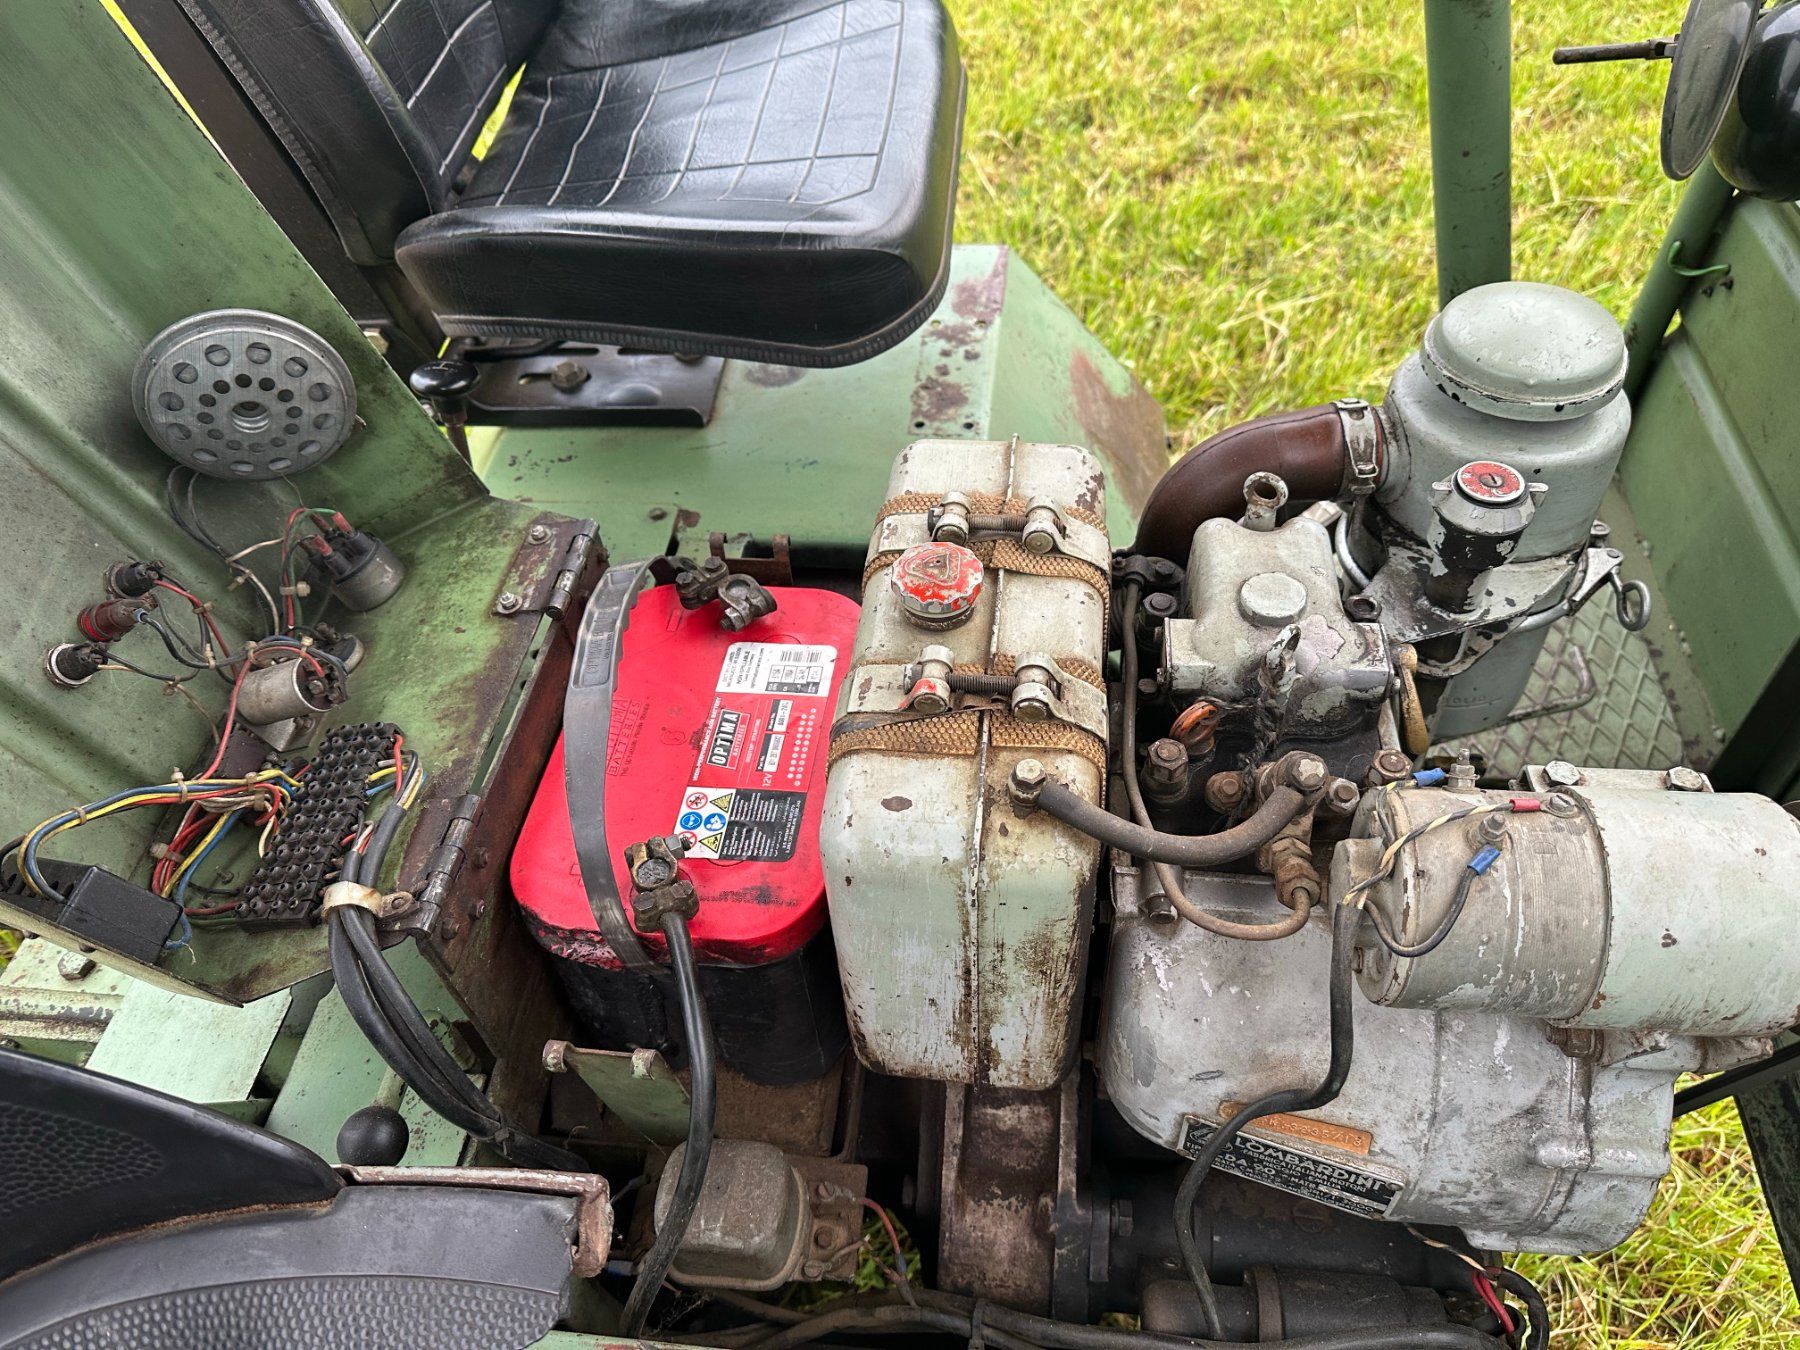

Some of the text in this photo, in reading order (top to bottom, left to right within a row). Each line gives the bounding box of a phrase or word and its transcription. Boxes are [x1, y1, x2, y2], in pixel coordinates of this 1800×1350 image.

[607, 700, 640, 774] BATTERIES
[709, 711, 739, 765] OPTIMA
[731, 723, 746, 756] BATTERIES
[760, 771, 773, 788] 12V
[1235, 1136, 1387, 1190] LOMBARDINI
[1242, 1148, 1367, 1193] FABBRICA ITALIANA MOTORI
[1262, 1160, 1301, 1176] REGGIO
[1307, 1175, 1342, 1190] EMILIA
